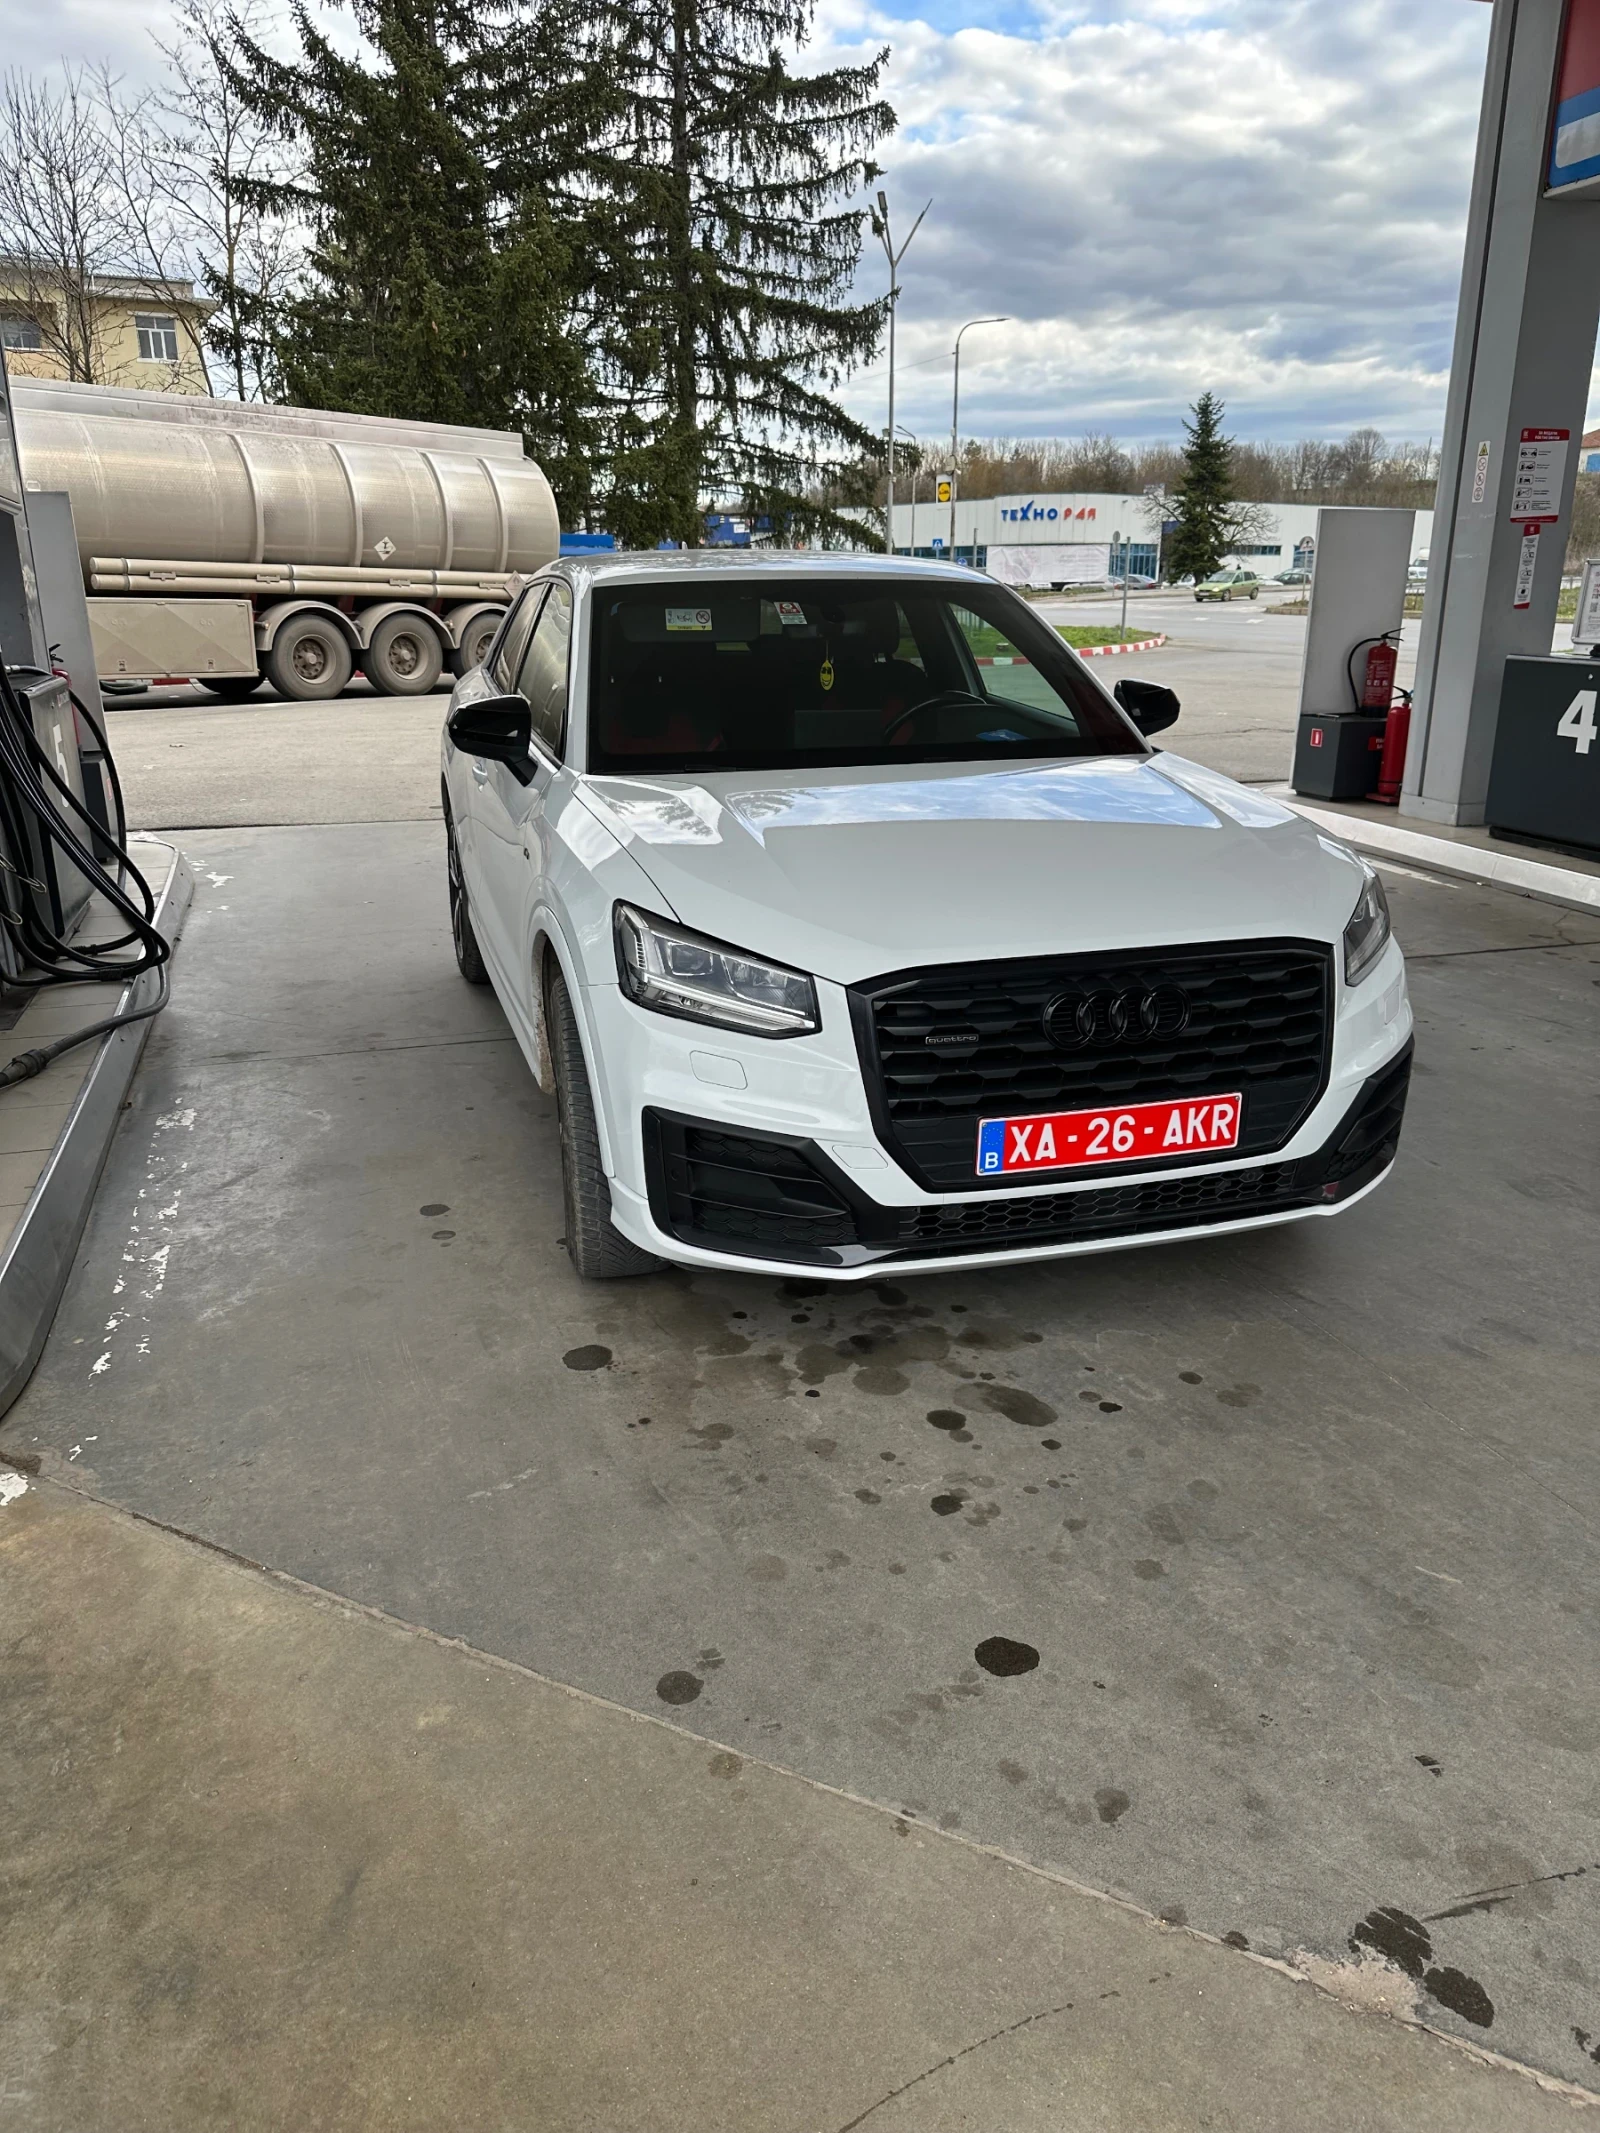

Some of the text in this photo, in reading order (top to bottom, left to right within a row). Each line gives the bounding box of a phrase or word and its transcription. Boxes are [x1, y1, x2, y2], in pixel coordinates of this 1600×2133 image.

[1001, 500, 1058, 522] ТЕХНО
[1557, 689, 1598, 755] 4
[927, 1036, 977, 1044] quattro
[984, 1152, 999, 1169] B
